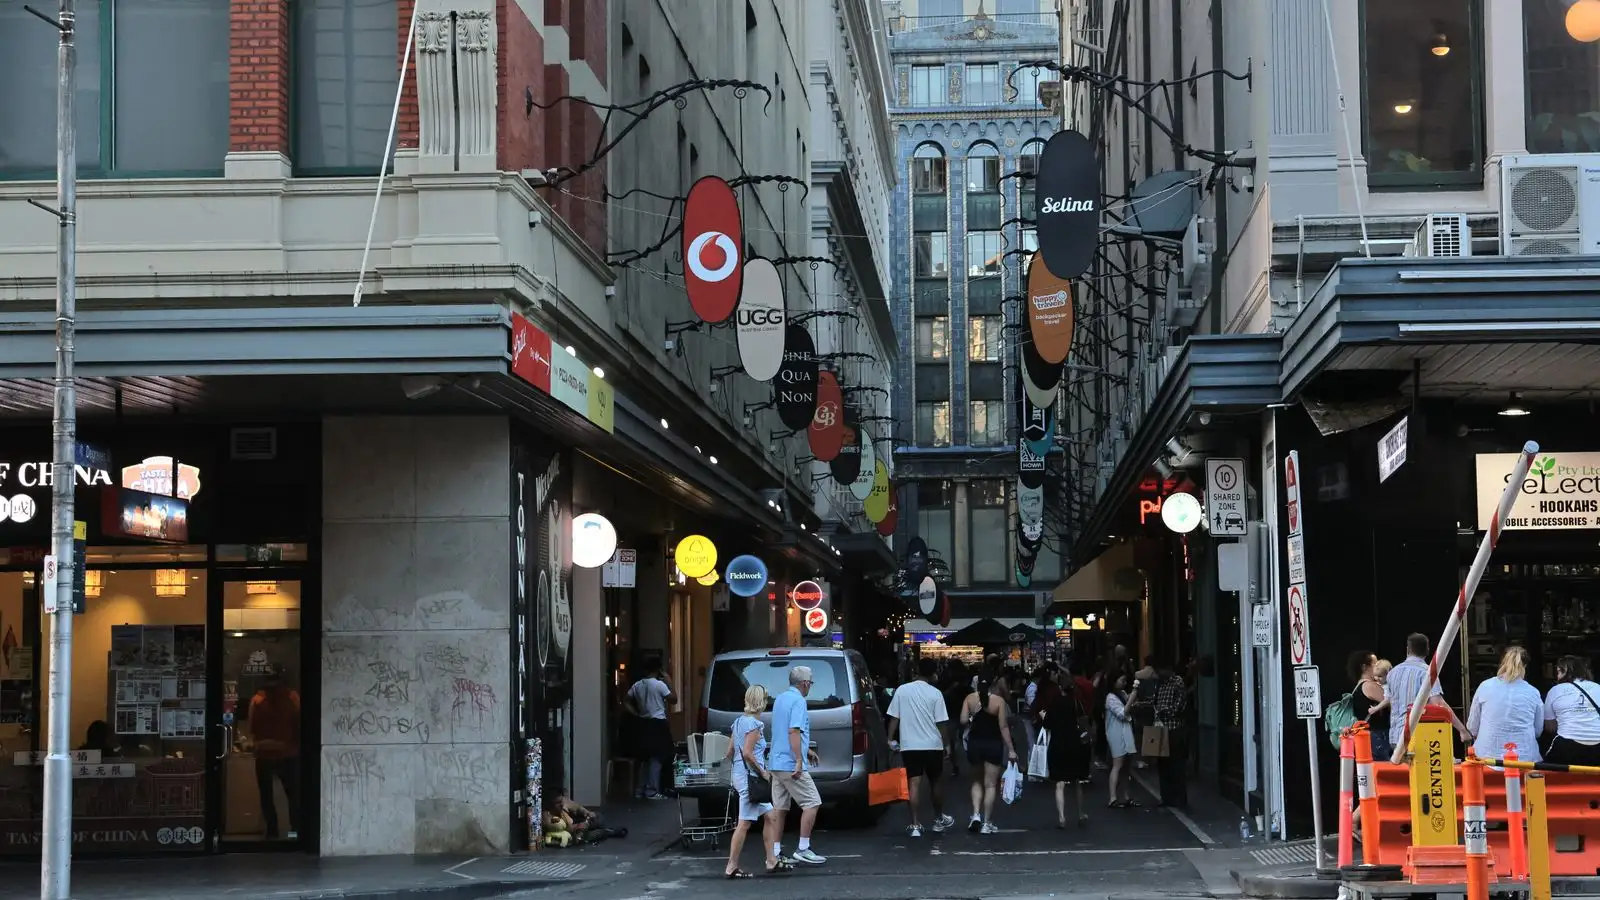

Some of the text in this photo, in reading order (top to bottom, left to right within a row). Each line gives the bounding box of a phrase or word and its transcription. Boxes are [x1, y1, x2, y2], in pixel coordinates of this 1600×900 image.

[1042, 197, 1094, 213] Selina
[1034, 295, 1058, 304] happy
[738, 309, 782, 325] UGG
[781, 369, 811, 384] QUA
[781, 391, 812, 404] NON
[18, 462, 113, 487] CHNA
[141, 469, 166, 479] TASTE
[1558, 466, 1578, 477] Pty
[1220, 472, 1231, 483] 10
[1540, 500, 1597, 513] HOOKAHS
[1505, 517, 1587, 527] OBILE ACCESSORIES
[730, 572, 762, 580] Fieldwork
[1300, 672, 1308, 682] NO
[1296, 687, 1315, 698] THROUGH
[1300, 702, 1314, 713] ROAD
[1429, 740, 1443, 809] CENTSYS
[7, 831, 43, 844] TAS
[92, 829, 149, 842] CHINA
